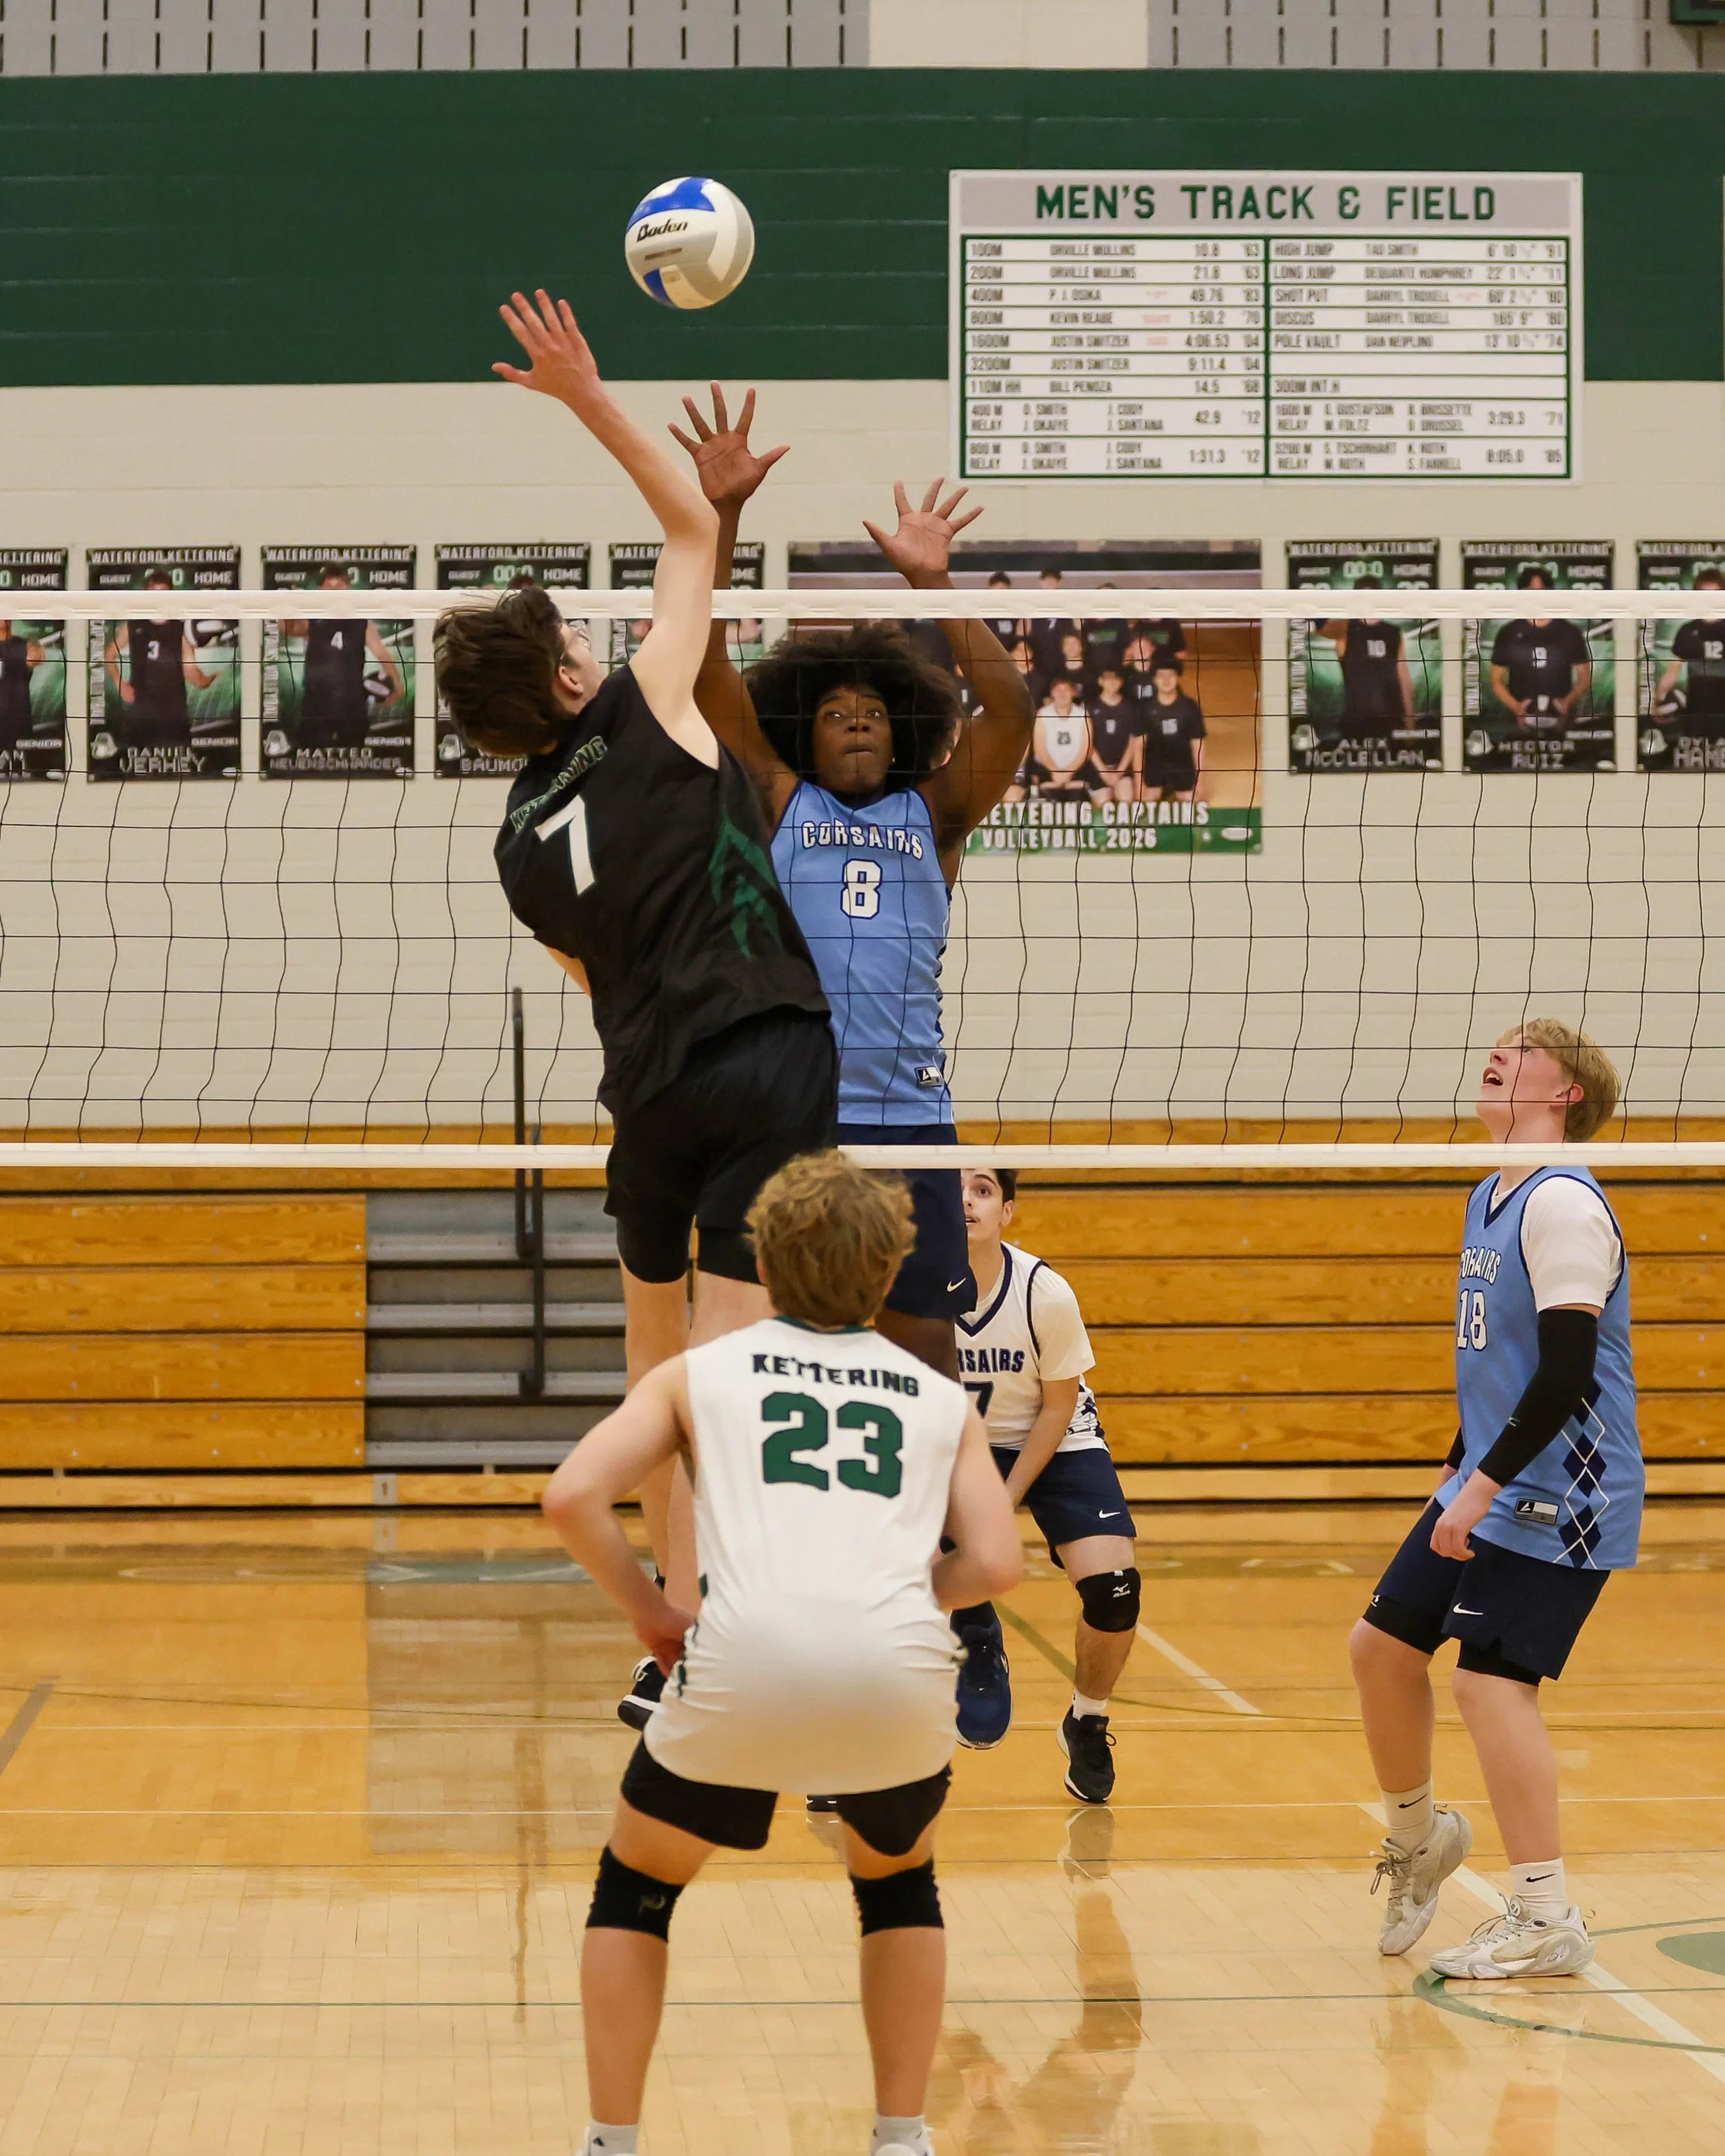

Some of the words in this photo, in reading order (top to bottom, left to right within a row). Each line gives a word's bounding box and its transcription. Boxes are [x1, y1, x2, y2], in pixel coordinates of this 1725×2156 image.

[1036, 184, 1156, 220] MEN'S
[1179, 184, 1316, 221] TRACK
[1337, 185, 1361, 220] &
[1386, 186, 1496, 221] FIELD
[636, 218, 689, 243] Baden
[91, 550, 163, 564] WATERFORD
[167, 548, 235, 563] KETTERING
[266, 548, 342, 561] WATERFORD
[343, 547, 411, 560] KETTERING
[440, 546, 513, 560] WATERFORD
[516, 544, 584, 559] KETTERING
[614, 546, 662, 558] WATER
[21, 573, 59, 587] HOME
[194, 571, 233, 585] HOME
[369, 569, 408, 584] HOME
[543, 568, 582, 582] HOME
[147, 640, 161, 660] 3
[330, 631, 344, 651] 4
[126, 746, 195, 758] DANIEL
[296, 747, 373, 759] MATTEO
[1337, 738, 1388, 750] ALEX
[1497, 740, 1576, 753] HECTOR
[119, 755, 206, 773] VERHEY
[1511, 753, 1565, 769] RUIZ
[1101, 800, 1210, 826] CAPTAINS
[534, 794, 595, 897] 7
[801, 818, 925, 861] CORSAIRS
[981, 828, 1097, 849] VOLLEYBALL
[1105, 827, 1158, 849] 2026
[840, 858, 883, 920] 8
[1457, 1289, 1488, 1352] 18
[957, 1347, 1025, 1374] RSAIRS
[751, 1353, 920, 1397] KETTERING
[760, 1390, 903, 1499] 23
